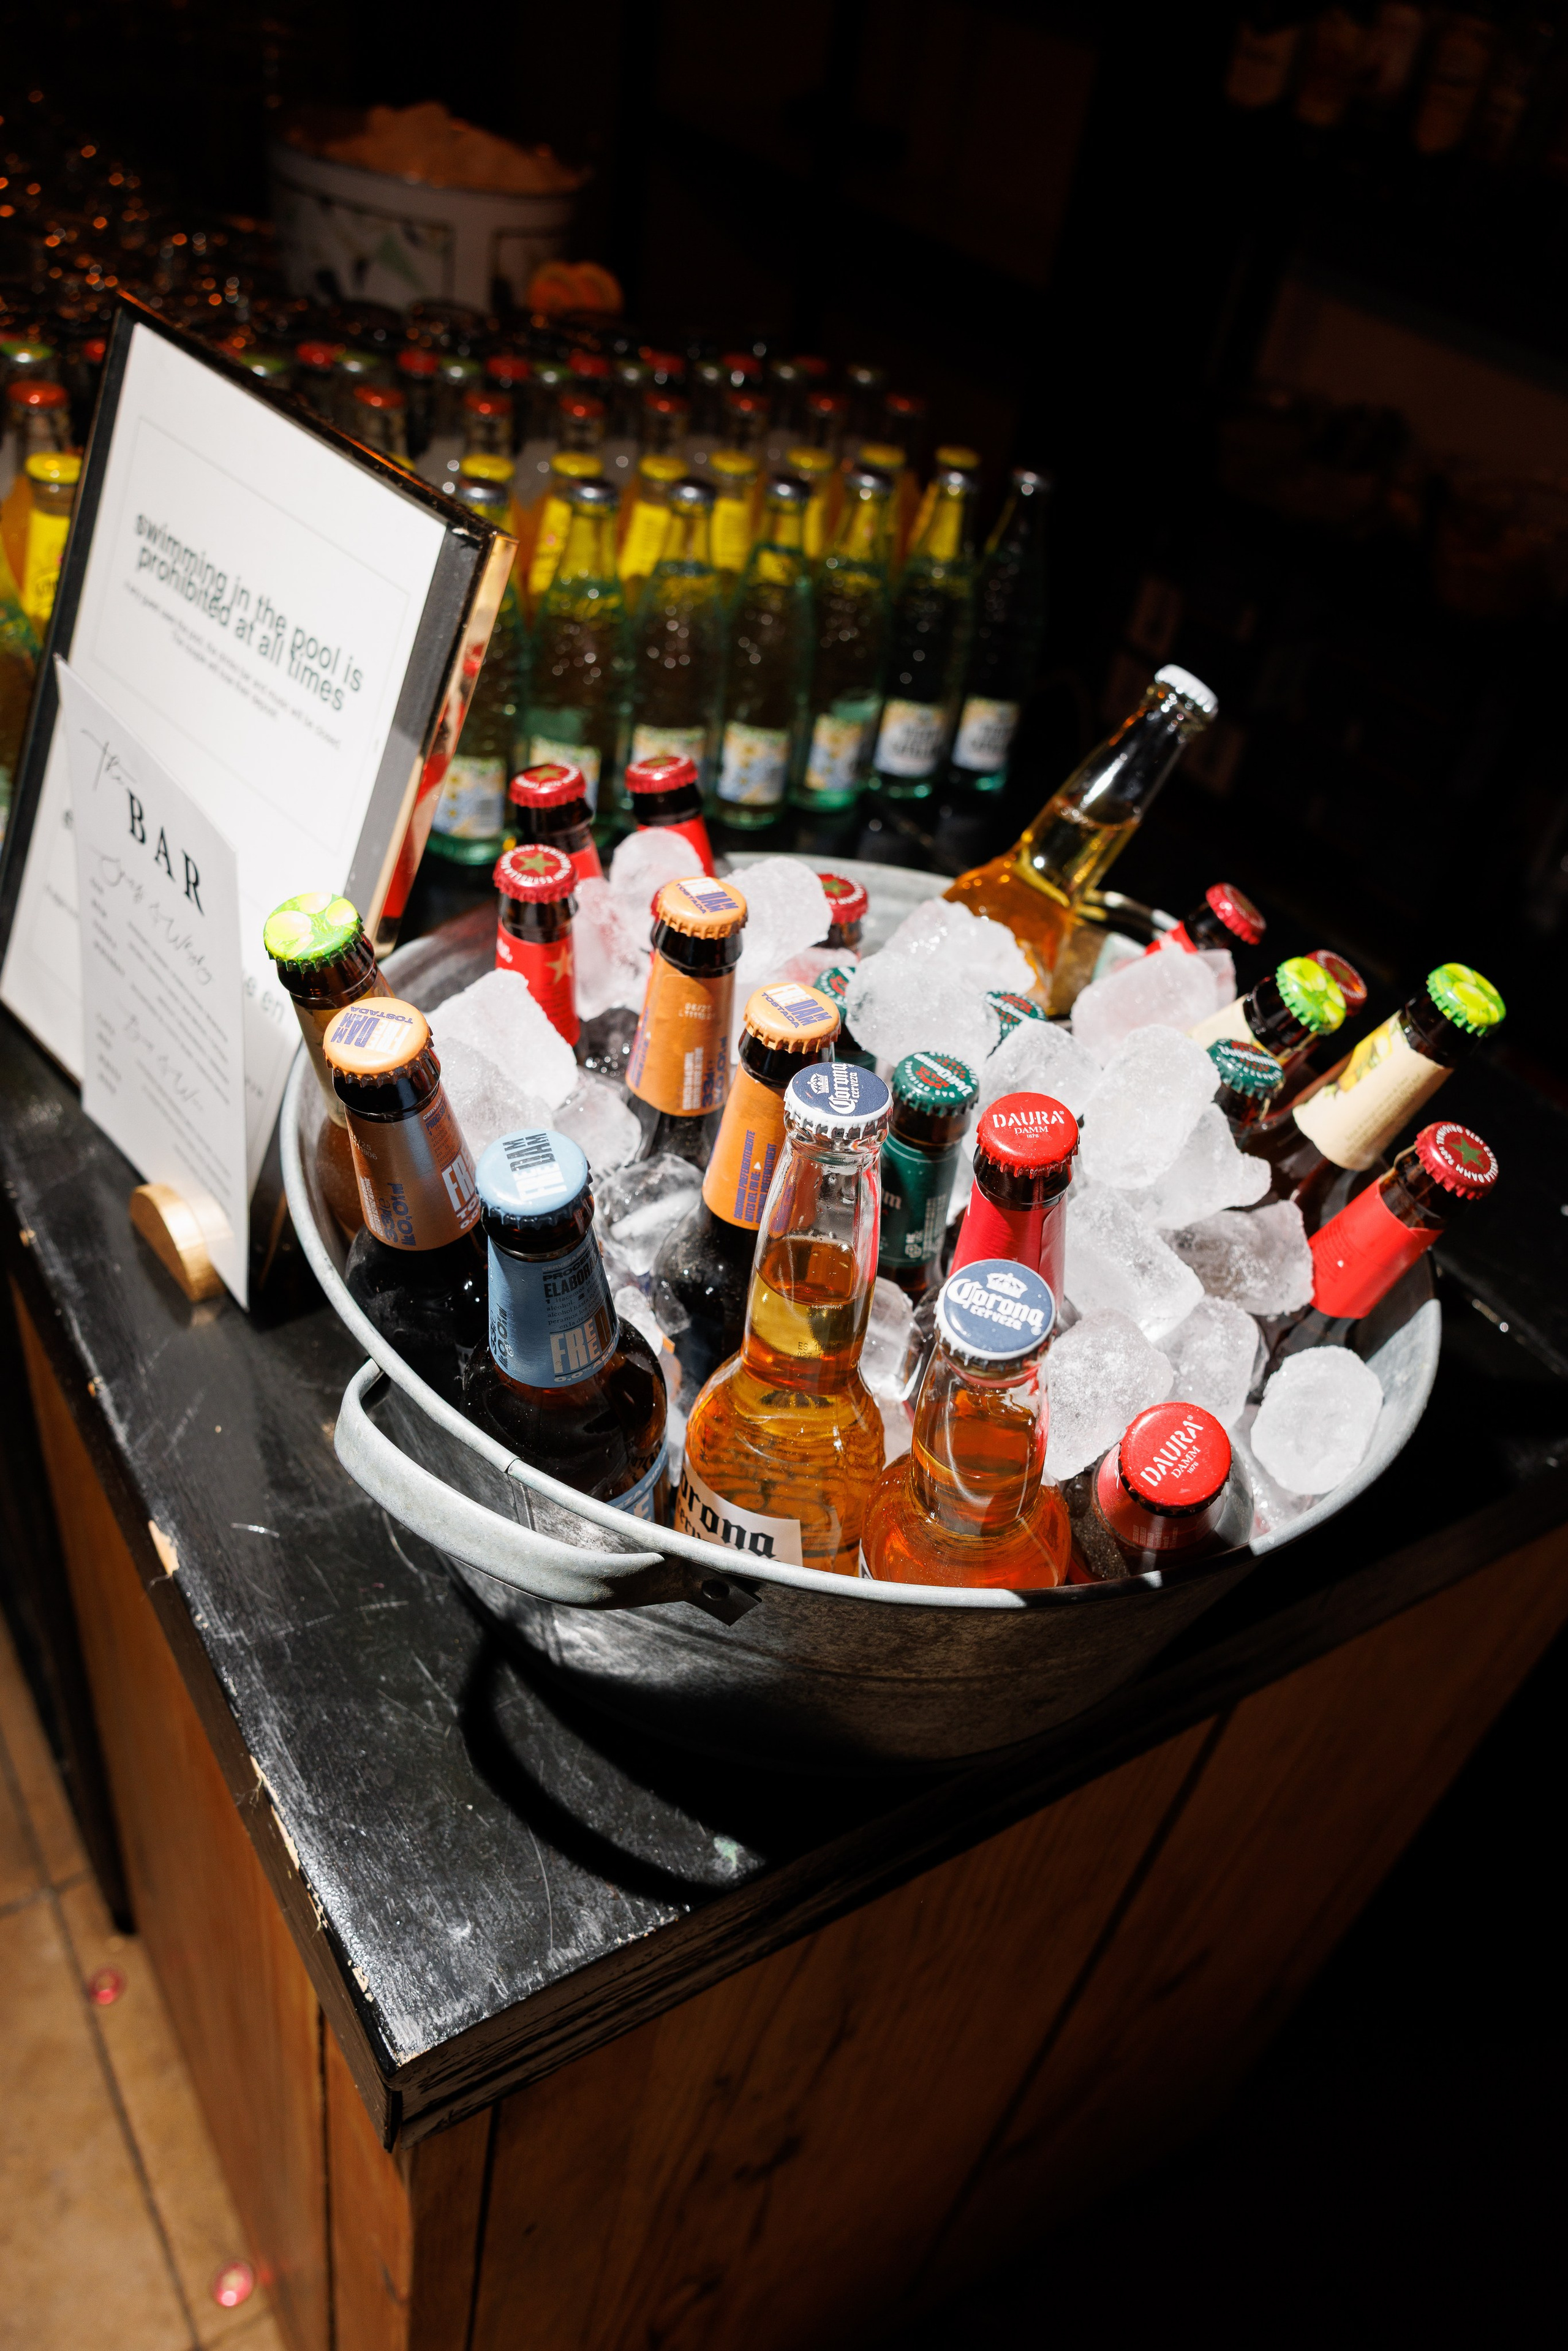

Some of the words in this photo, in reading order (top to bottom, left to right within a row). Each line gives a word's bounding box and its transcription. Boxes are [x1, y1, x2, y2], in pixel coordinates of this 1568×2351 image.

[135, 513, 228, 598] swimming
[233, 575, 251, 612] in
[256, 594, 287, 633] the
[291, 625, 341, 674] pool
[344, 655, 363, 693] is
[137, 545, 232, 628] prohibited
[235, 616, 254, 647] at
[257, 631, 286, 666] all
[288, 649, 345, 711] times
[127, 787, 205, 916] BAR
[676, 883, 707, 914] TOSTADA
[350, 1006, 413, 1024] TOSTADA
[761, 992, 799, 1028] TOSTADA
[828, 1063, 858, 1114] Corona
[850, 1072, 860, 1098] cerveza
[992, 1111, 1065, 1128] DAURA
[1455, 1164, 1485, 1183] DAMM
[542, 1256, 576, 1272] CERVEZA
[546, 1300, 575, 1311] alcohol.
[556, 1287, 584, 1303] Hacemos
[947, 1278, 1044, 1327] Corona
[548, 1307, 573, 1318] alcohol
[548, 1312, 578, 1326] peramos
[970, 1305, 1022, 1330] cerveza
[549, 1318, 601, 1375] FREE
[797, 1342, 808, 1351] ES
[1140, 1421, 1204, 1487] DAURA
[1171, 1445, 1201, 1479] DAMM
[1187, 1461, 1199, 1474] 1876
[680, 1469, 777, 1560] orona
